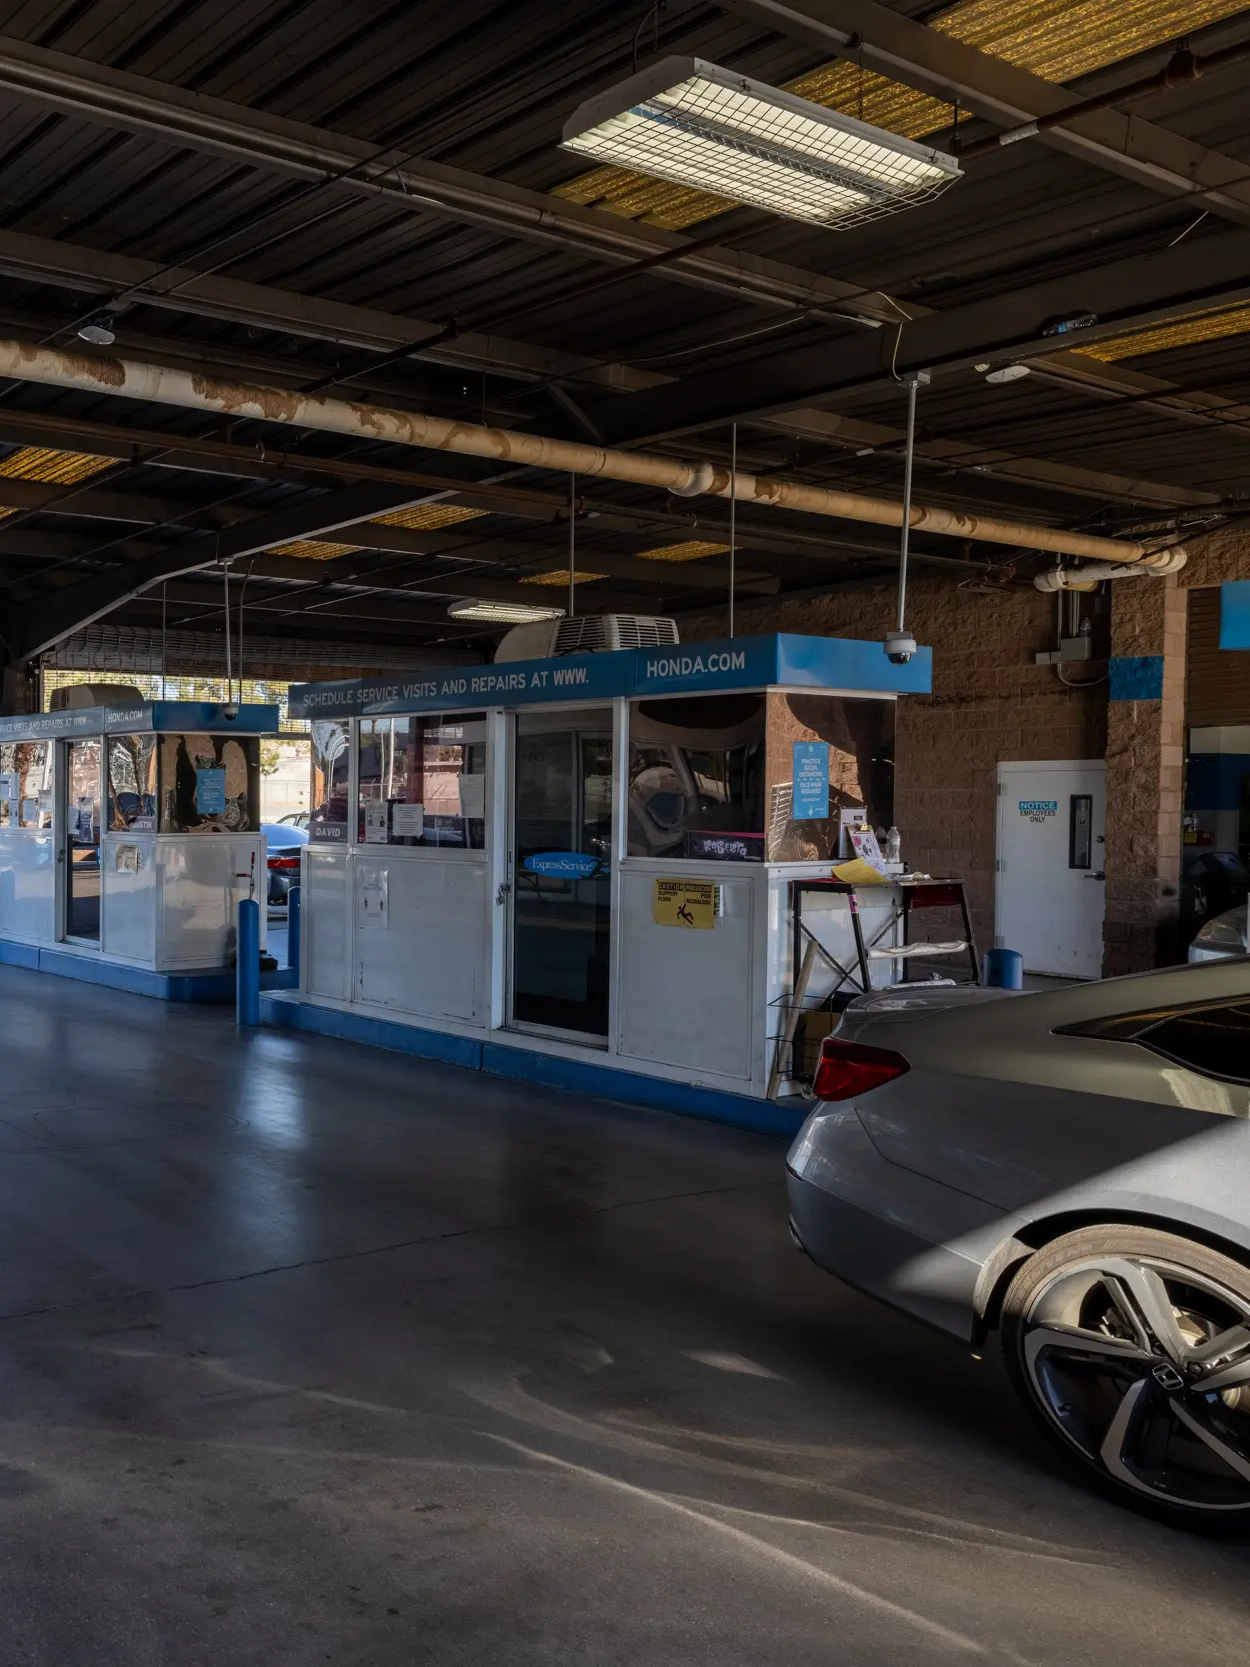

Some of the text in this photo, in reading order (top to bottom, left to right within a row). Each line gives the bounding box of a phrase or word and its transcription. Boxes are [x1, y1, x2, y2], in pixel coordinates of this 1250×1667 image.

[302, 651, 745, 708] SCHEDULE SERVICE VISITS AND REPAIRS AT WWW. HONDA.COM
[13, 721, 29, 732] VISITS
[29, 720, 41, 732] AND
[41, 718, 63, 730] REPAIRS
[64, 717, 72, 727] AT
[107, 710, 143, 724] HONDA.COM
[1020, 801, 1056, 810] NOTICE
[132, 820, 152, 829] JUSTIN
[315, 827, 341, 837] DAVID
[703, 840, 748, 856] ROBERTO
[658, 883, 684, 891] CAUTION
